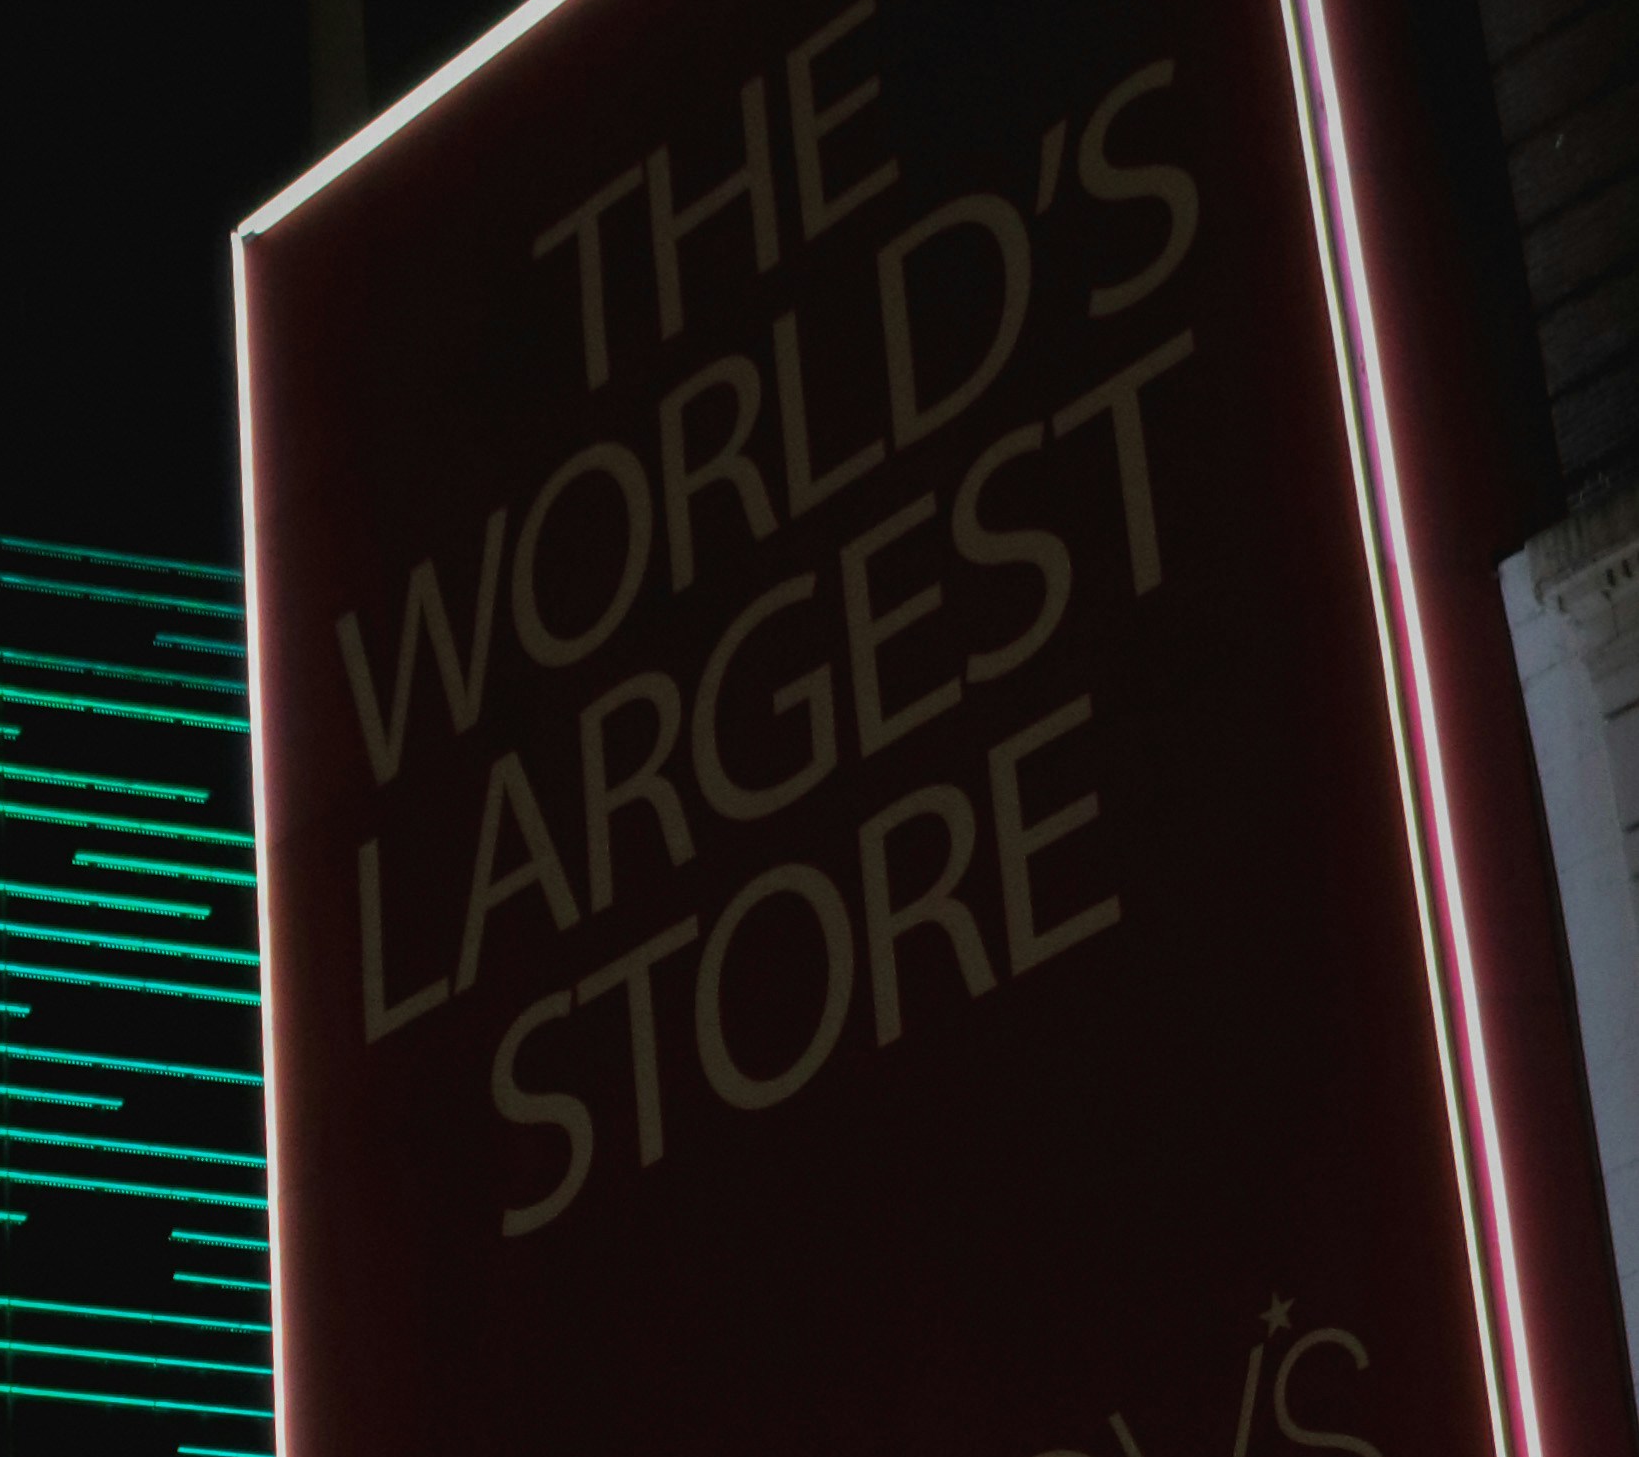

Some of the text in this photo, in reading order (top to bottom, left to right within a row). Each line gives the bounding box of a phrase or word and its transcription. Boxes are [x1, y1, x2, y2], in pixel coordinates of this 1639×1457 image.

[336, 58, 1200, 786] WORLD'S
[359, 328, 1194, 1045] LARGEST
[490, 692, 1122, 1238] STORE
